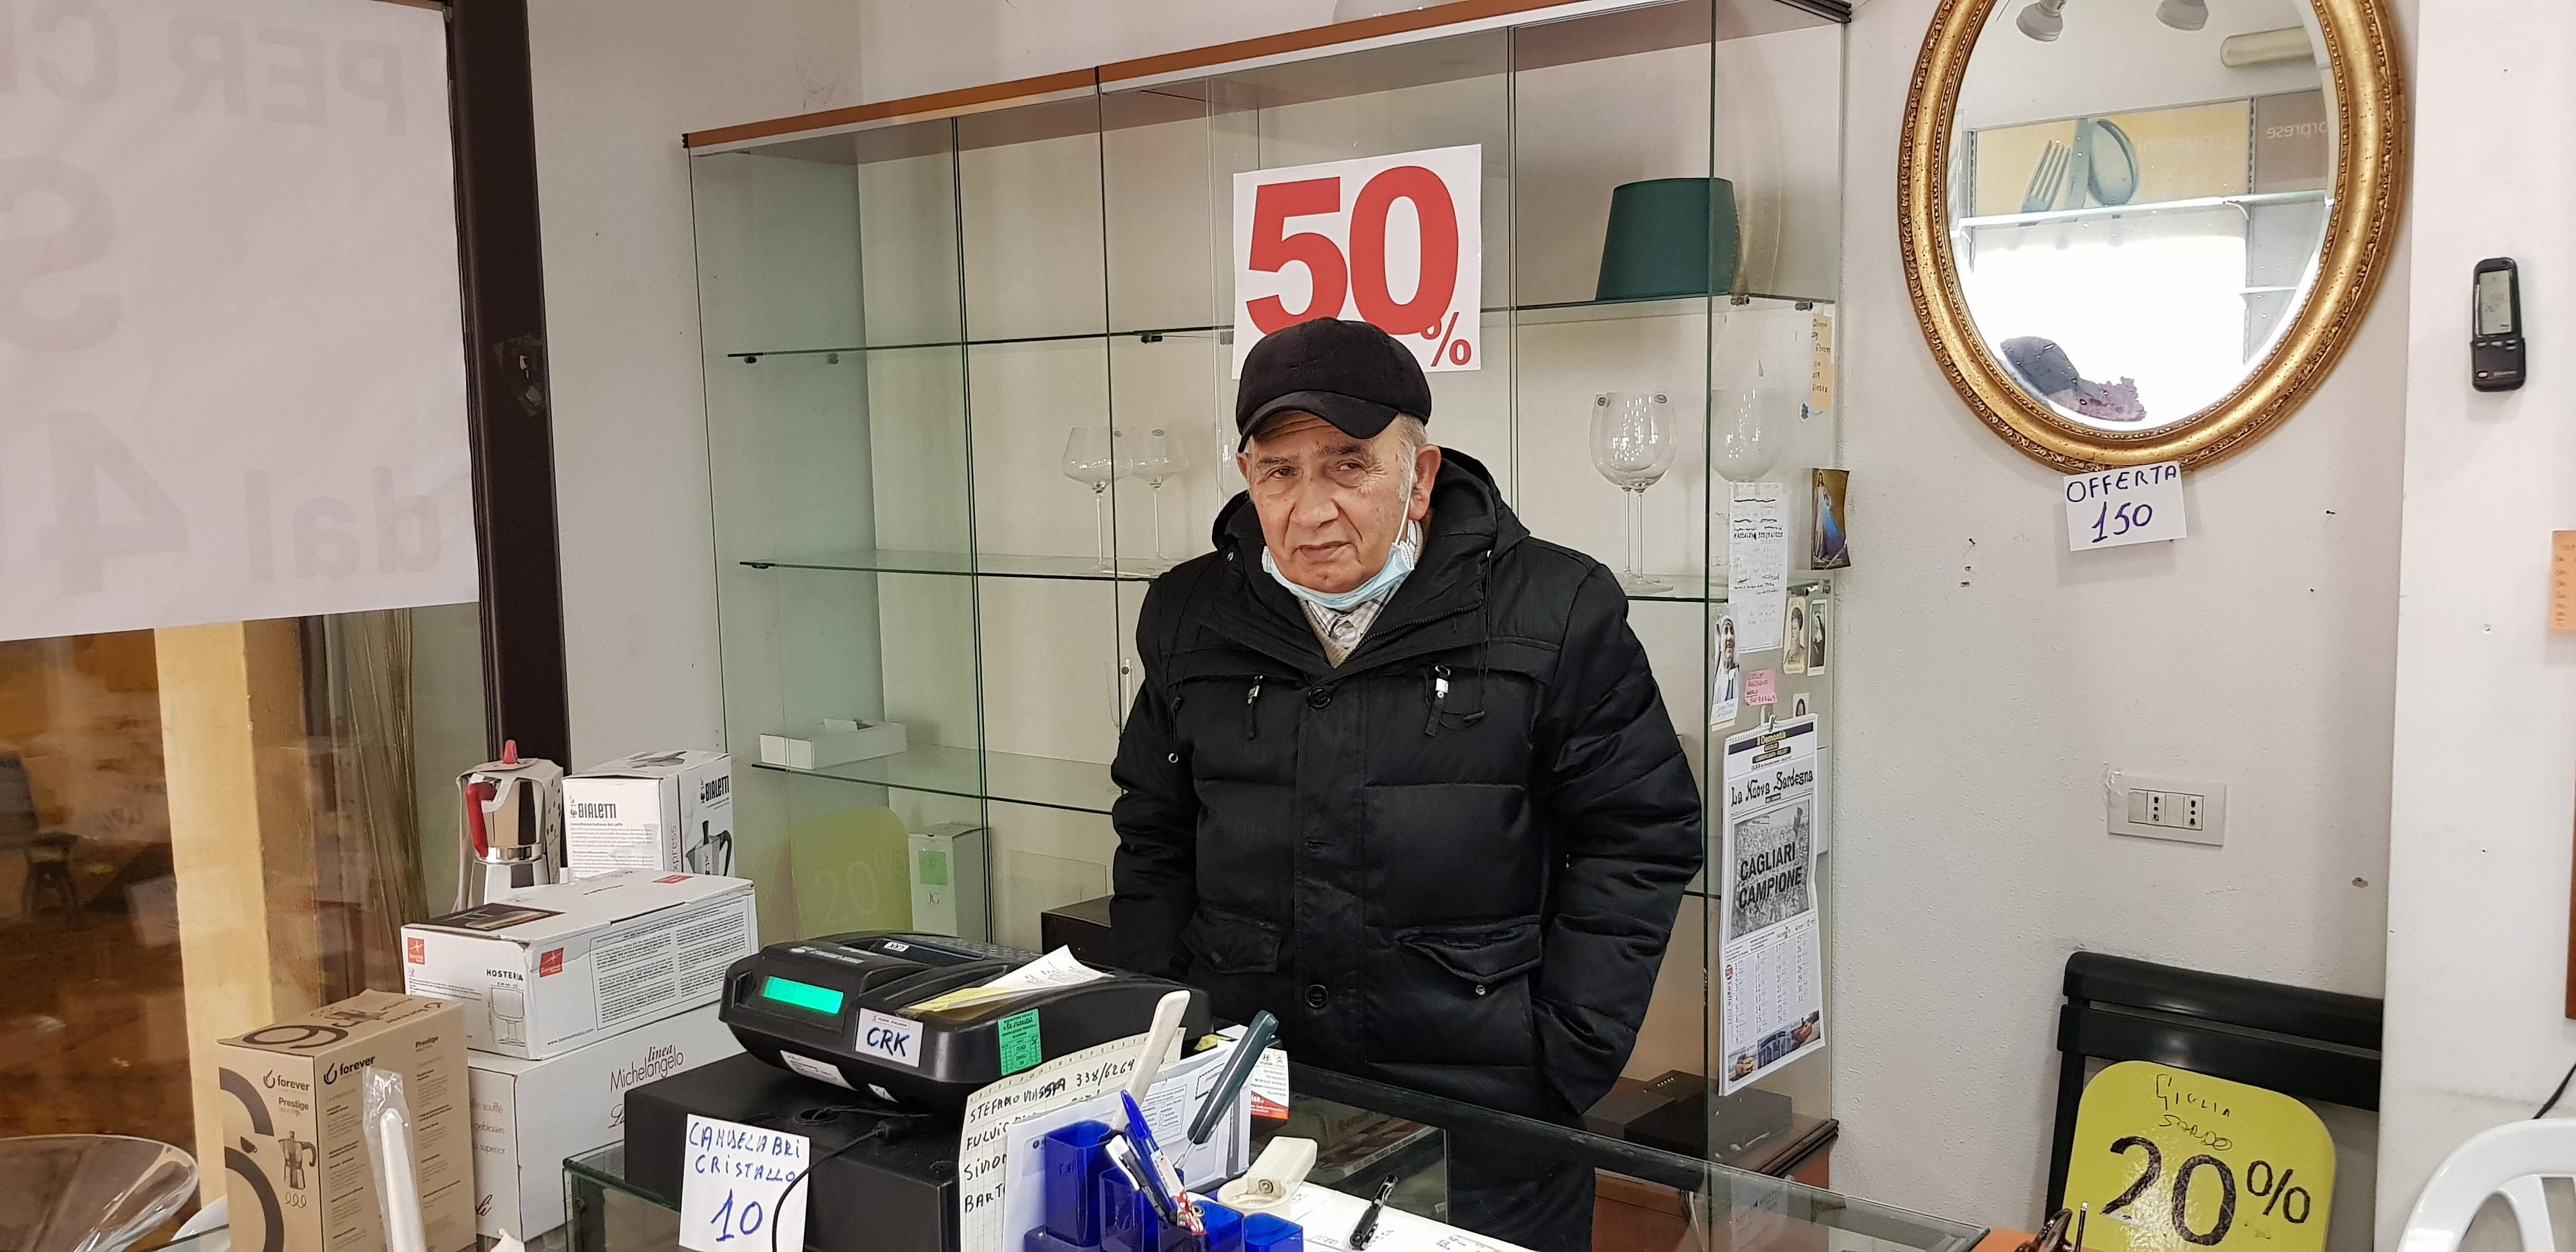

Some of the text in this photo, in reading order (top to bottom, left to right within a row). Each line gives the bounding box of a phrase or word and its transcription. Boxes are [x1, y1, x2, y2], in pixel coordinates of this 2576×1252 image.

[1246, 165, 1471, 367] 50%
[2066, 464, 2177, 503] OFFERTA
[2091, 501, 2153, 543] 150
[1731, 786, 1743, 807] La
[1745, 779, 1770, 802] Nuova
[1773, 767, 1813, 793] Sardegna
[578, 802, 617, 819] BIALETTI
[1740, 841, 1795, 881] CAGLIARI
[1738, 865, 1802, 909] CAMPIONE
[486, 968, 524, 982] HOSTERIA
[415, 1035, 440, 1049] Prestige
[647, 1044, 673, 1062] linea
[866, 1027, 911, 1058] CRK
[277, 1074, 310, 1092] forever
[340, 1055, 376, 1076] forever
[609, 1045, 684, 1092] Michelangelo
[278, 1097, 309, 1111] Prestige
[2099, 1135, 2311, 1246] 20%
[710, 1187, 763, 1242] 10
